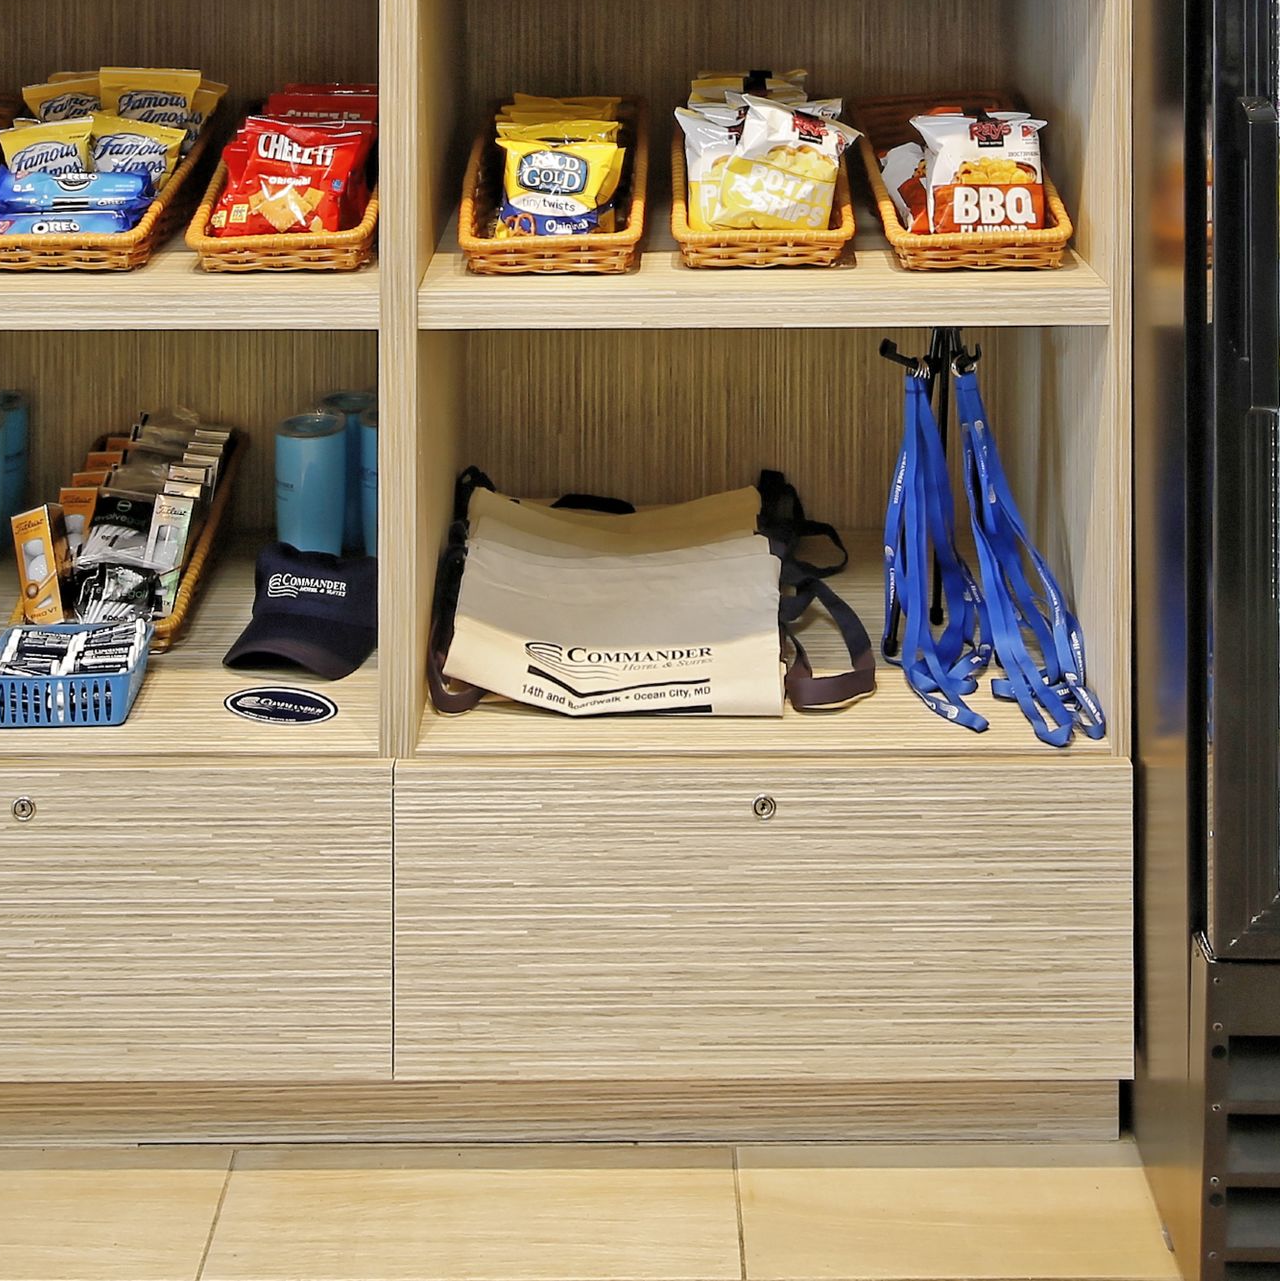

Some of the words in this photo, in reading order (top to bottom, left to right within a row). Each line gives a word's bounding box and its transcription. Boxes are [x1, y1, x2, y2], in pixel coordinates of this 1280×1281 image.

[118, 90, 187, 111] Famous
[12, 144, 77, 172] Famous
[94, 135, 168, 161] Famous
[523, 168, 581, 191] GOLD
[749, 164, 834, 207] POTAT
[522, 196, 543, 209] tiny
[543, 197, 576, 212] twists
[953, 186, 1037, 225] BBQ
[32, 221, 80, 234] OREO
[282, 573, 347, 591] COMMANDER
[567, 647, 712, 663] COMMANDER
[622, 663, 659, 671] HOTEL
[521, 684, 545, 699] 14th
[546, 692, 566, 704] and
[567, 696, 621, 710] Boardwalk
[633, 691, 666, 701] Ocean
[669, 687, 692, 699] City,
[694, 686, 711, 695] MD
